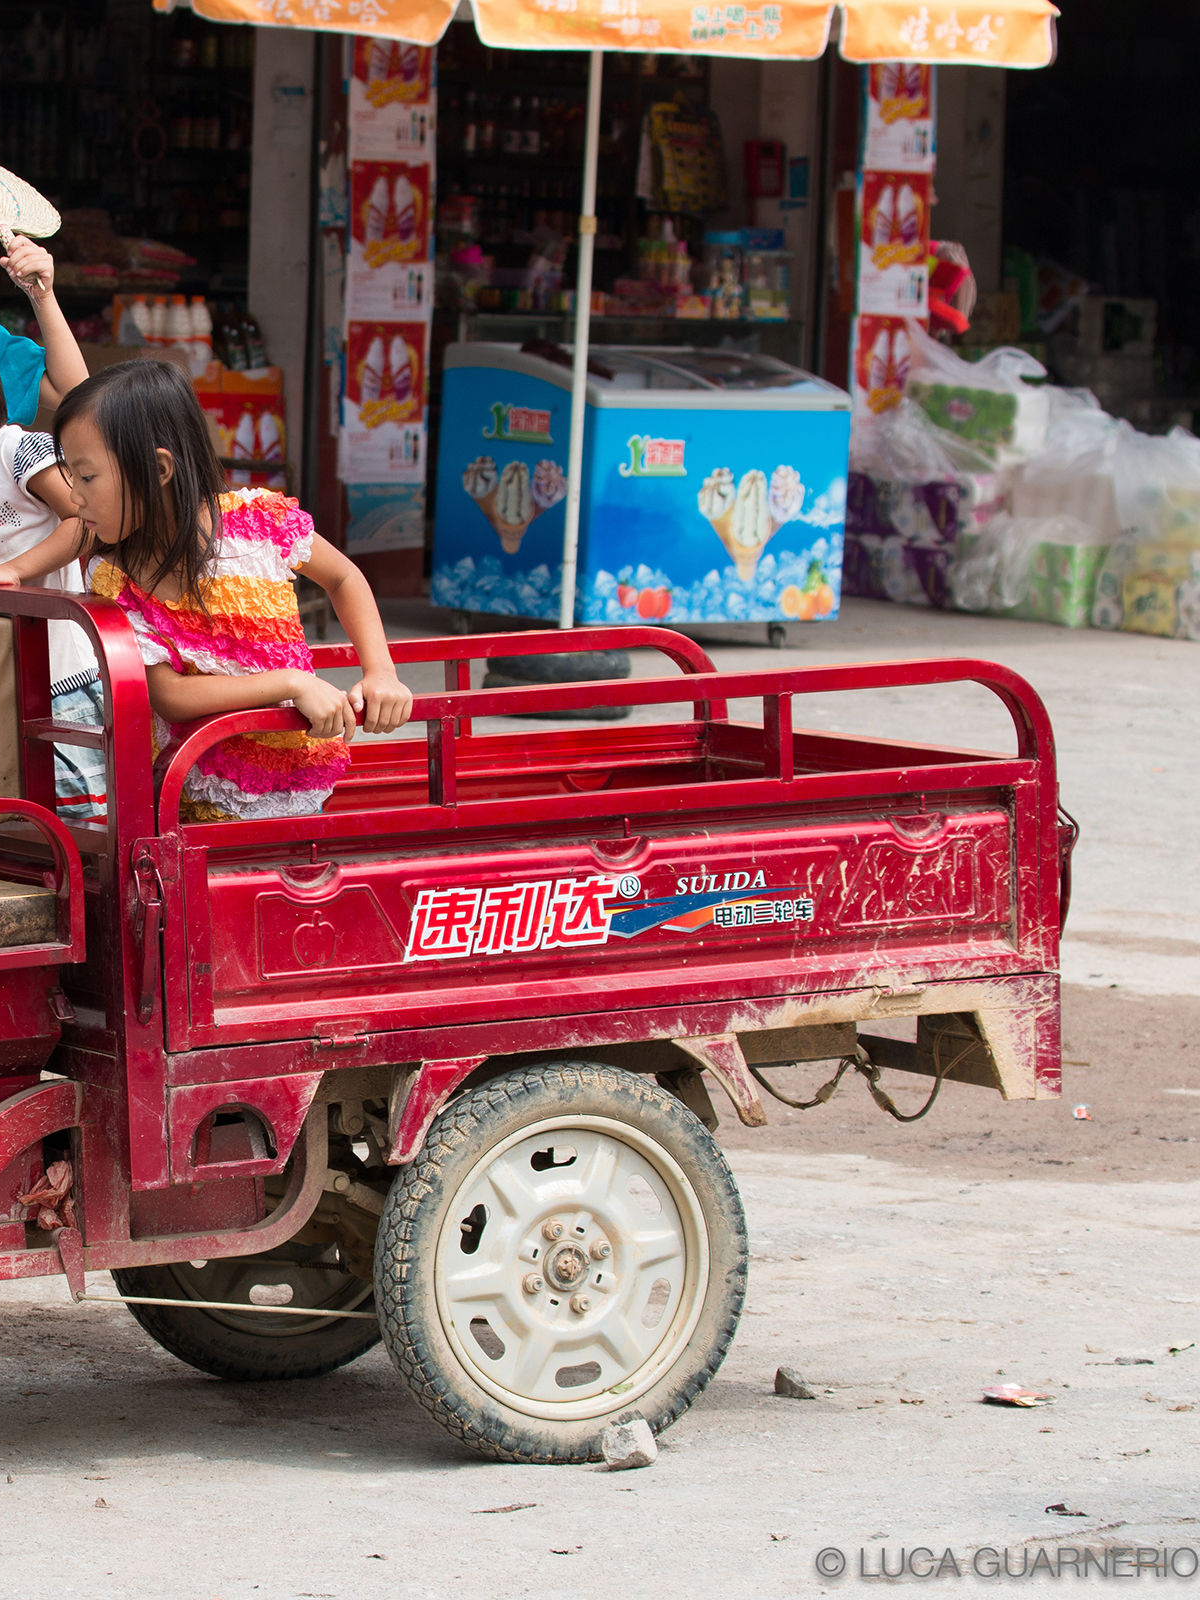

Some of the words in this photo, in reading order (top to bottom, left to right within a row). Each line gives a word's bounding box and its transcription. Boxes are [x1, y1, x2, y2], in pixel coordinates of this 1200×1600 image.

[675, 868, 768, 897] SULIDA
[403, 874, 618, 964] 速利达
[713, 898, 815, 929] 电动三轮车
